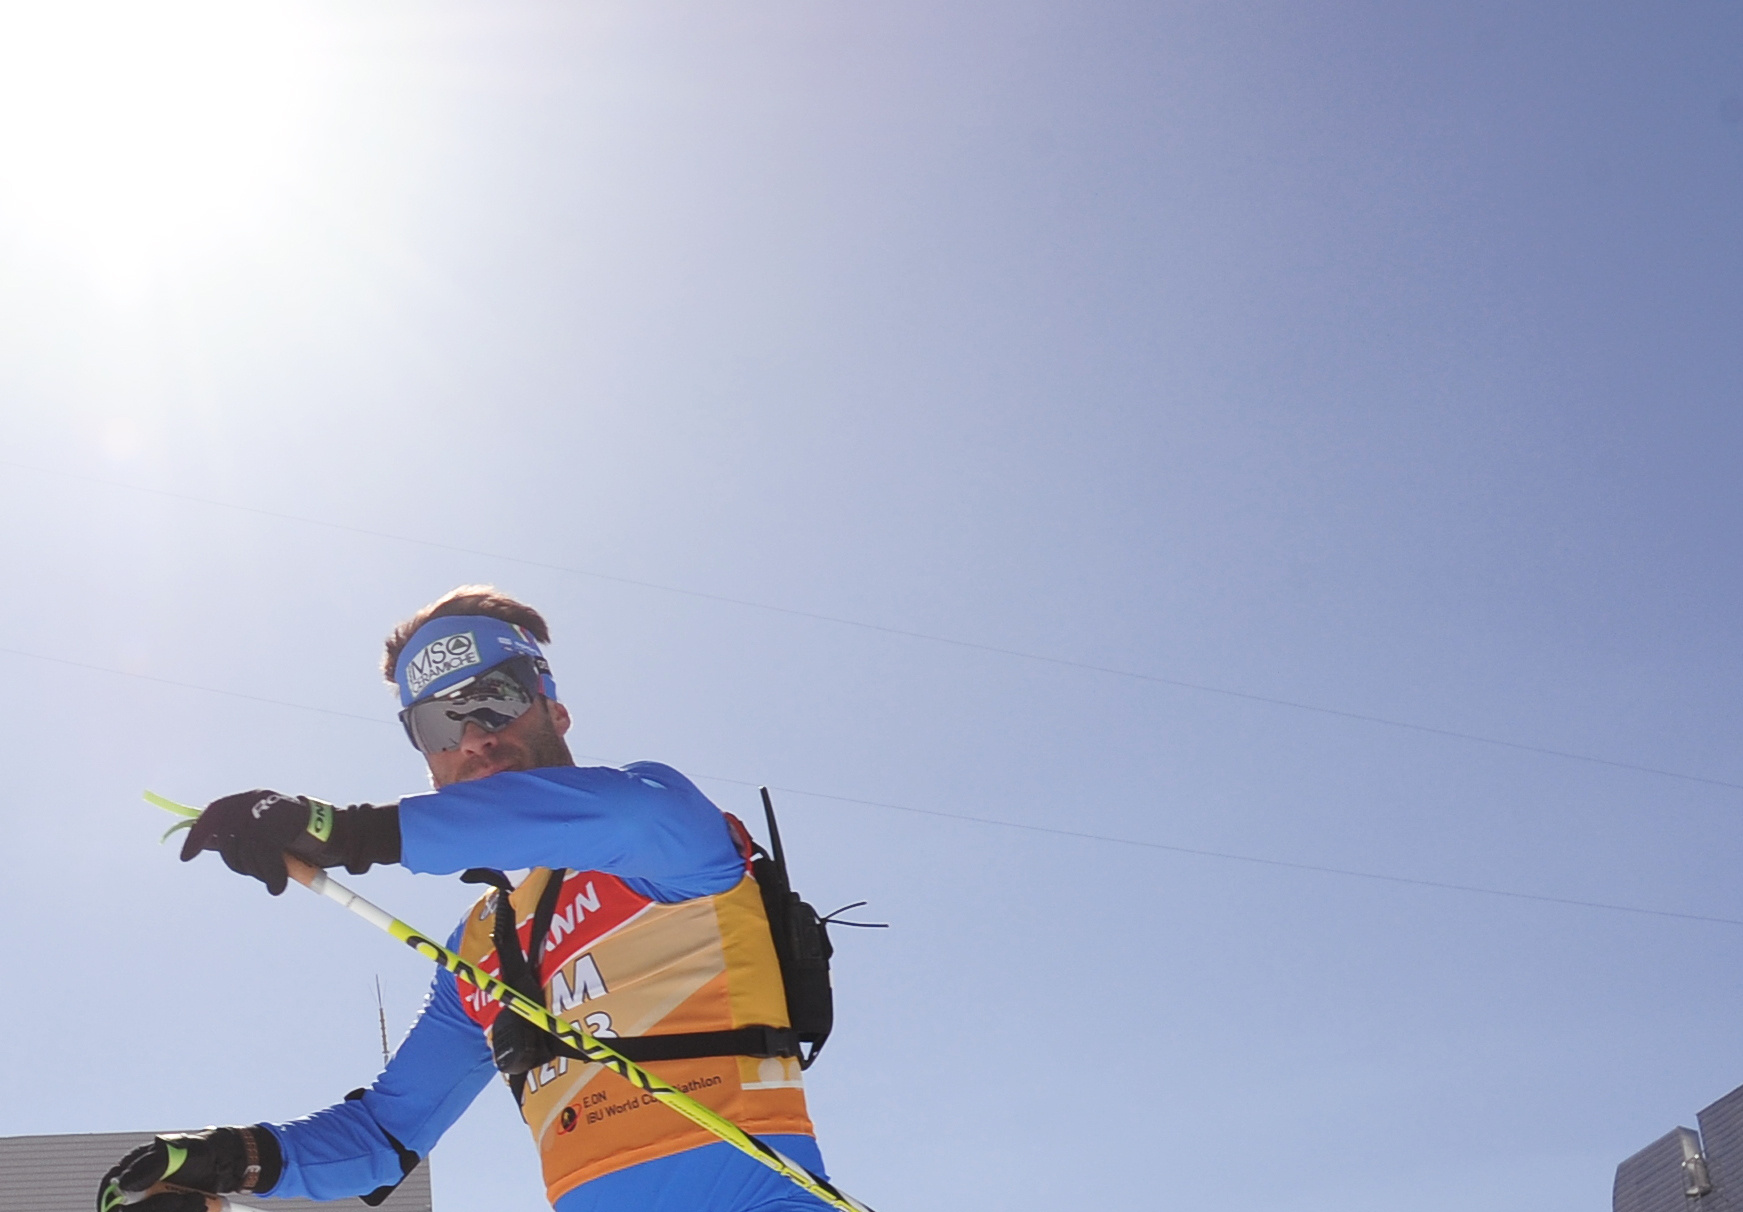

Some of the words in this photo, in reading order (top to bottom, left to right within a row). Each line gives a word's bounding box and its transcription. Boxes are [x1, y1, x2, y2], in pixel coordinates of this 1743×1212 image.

[411, 651, 477, 694] CERAMICHE
[586, 1112, 604, 1125] IBU
[607, 1099, 640, 1117] World
[641, 1093, 660, 1106] Cu
[672, 1075, 722, 1094] iathlon
